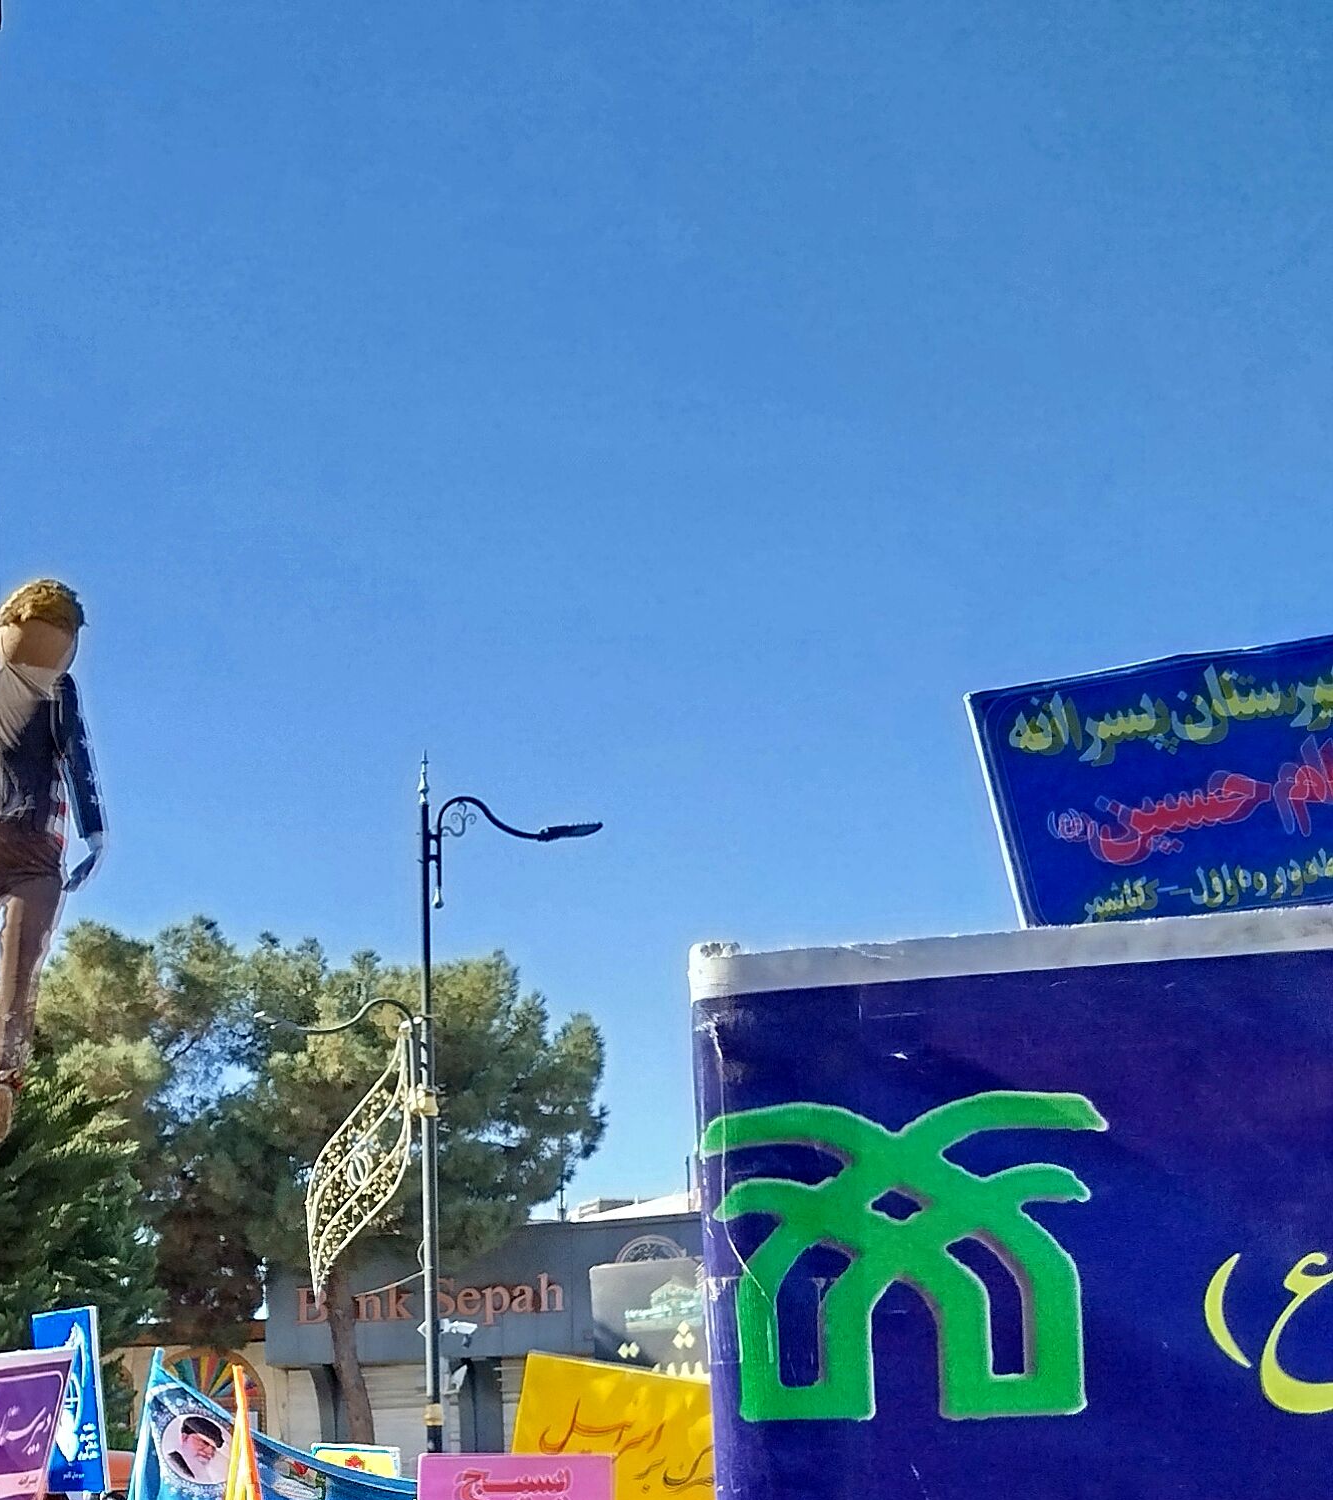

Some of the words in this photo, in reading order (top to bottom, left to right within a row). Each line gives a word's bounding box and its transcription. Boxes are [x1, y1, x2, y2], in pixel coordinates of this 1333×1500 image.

[1088, 770, 1272, 866] حسین
[295, 1284, 414, 1325] Bnk
[436, 1272, 565, 1327] Sepah
